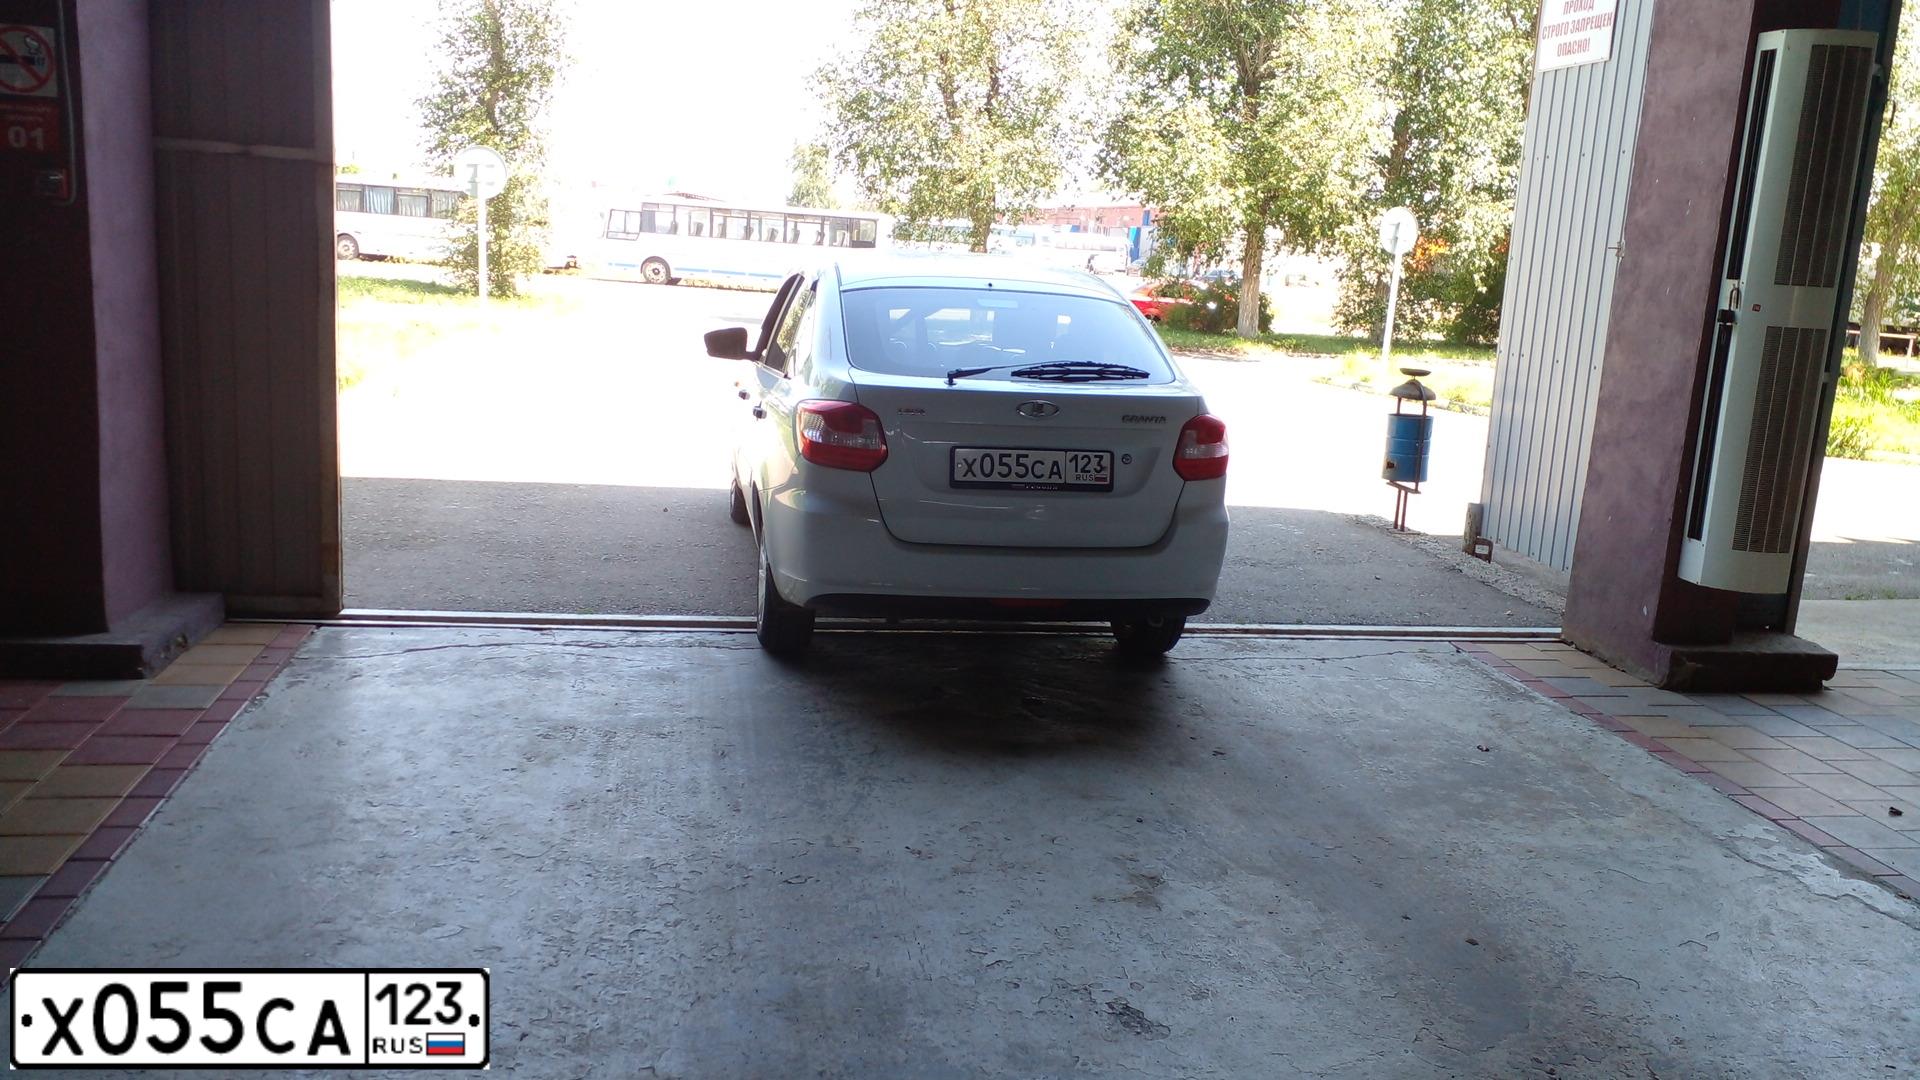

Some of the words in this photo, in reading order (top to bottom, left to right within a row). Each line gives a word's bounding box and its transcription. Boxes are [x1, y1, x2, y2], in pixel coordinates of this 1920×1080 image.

[1563, 0, 1595, 15] ПРОХОД
[1542, 21, 1569, 40] СТРОГО
[1570, 12, 1613, 34] ЗАПРЕЩЕН
[1557, 37, 1591, 57] ОПАСНО!
[8, 125, 44, 151] 01
[1068, 454, 1105, 474] 123
[1075, 474, 1094, 482] RUS
